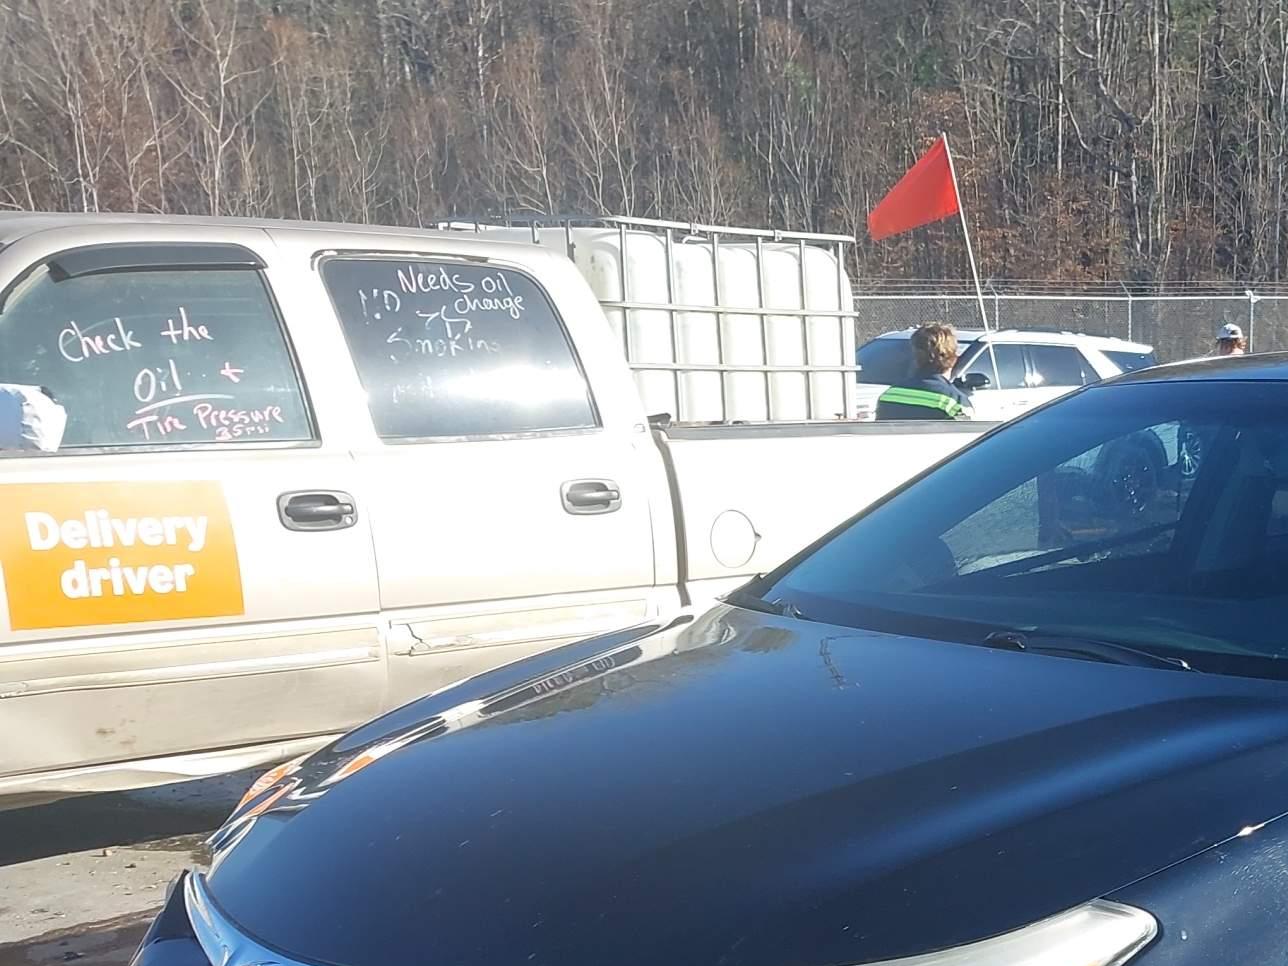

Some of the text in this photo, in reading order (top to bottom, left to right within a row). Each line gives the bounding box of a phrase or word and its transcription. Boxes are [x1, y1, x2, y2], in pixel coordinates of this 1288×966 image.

[398, 266, 475, 294] Needs
[455, 294, 525, 319] change
[59, 307, 215, 362] Check the
[193, 403, 285, 430] Pressure
[24, 507, 208, 552] Delivery
[60, 557, 196, 600] driver
